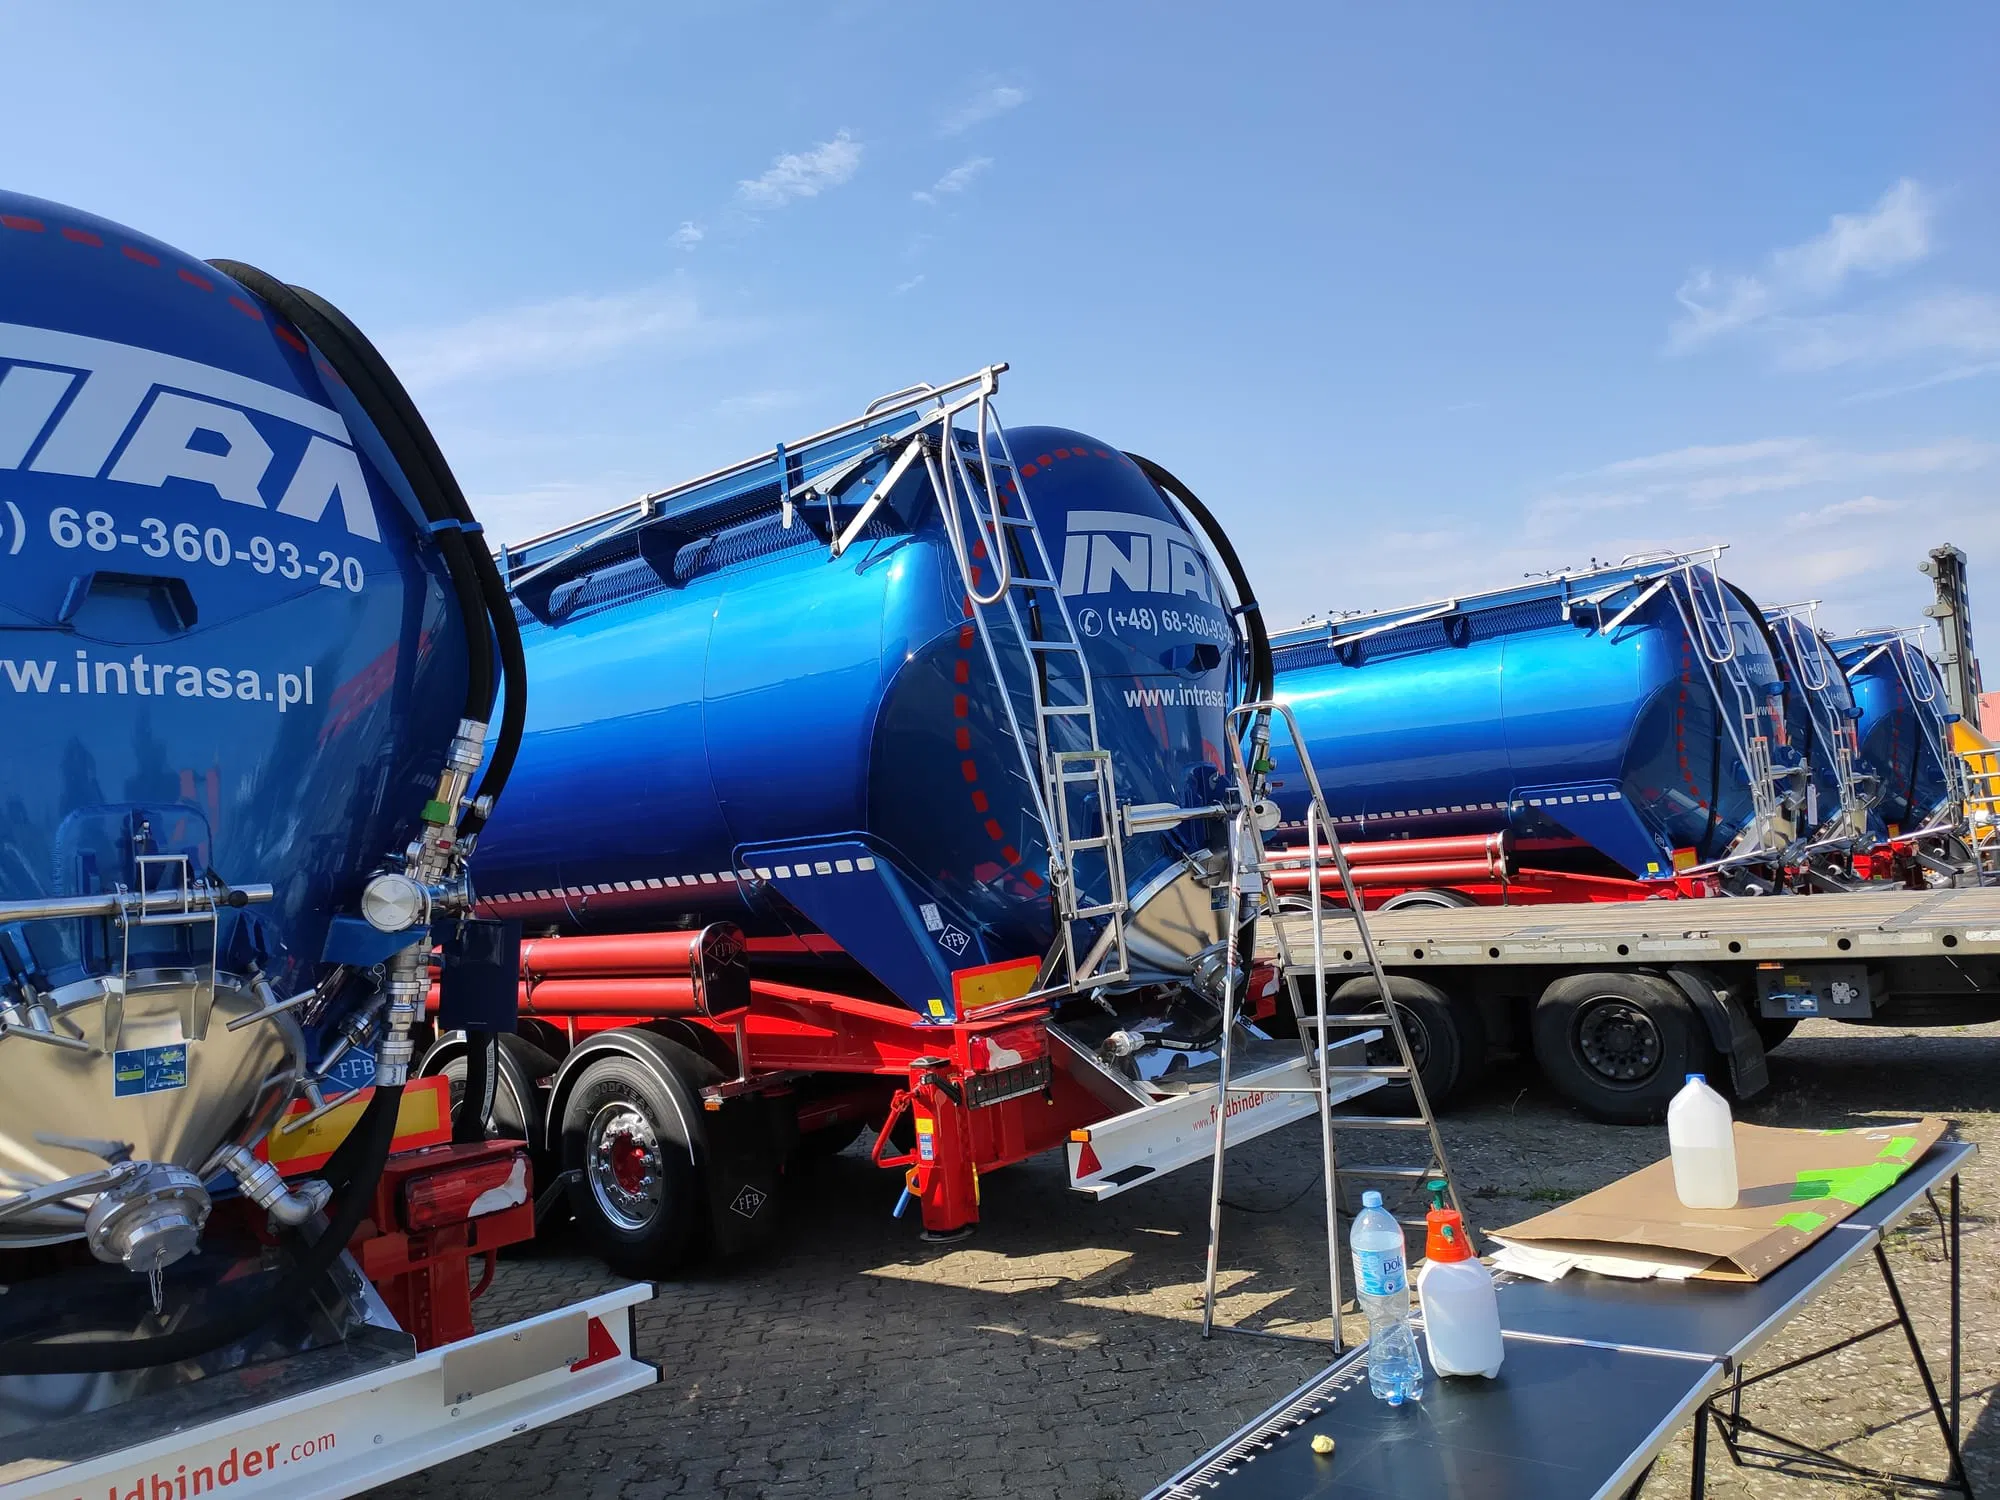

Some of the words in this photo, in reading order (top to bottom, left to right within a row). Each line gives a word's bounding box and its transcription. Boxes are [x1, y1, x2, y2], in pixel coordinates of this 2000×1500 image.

[49, 507, 364, 593] 68-360-93-20
[1108, 608, 1158, 636] (+48)
[0, 650, 313, 712] w.intrasa.pl
[1123, 684, 1230, 713] www.intrasa.p
[945, 933, 965, 947] FFB
[338, 1058, 376, 1079] FFB
[739, 1193, 760, 1210] FFB
